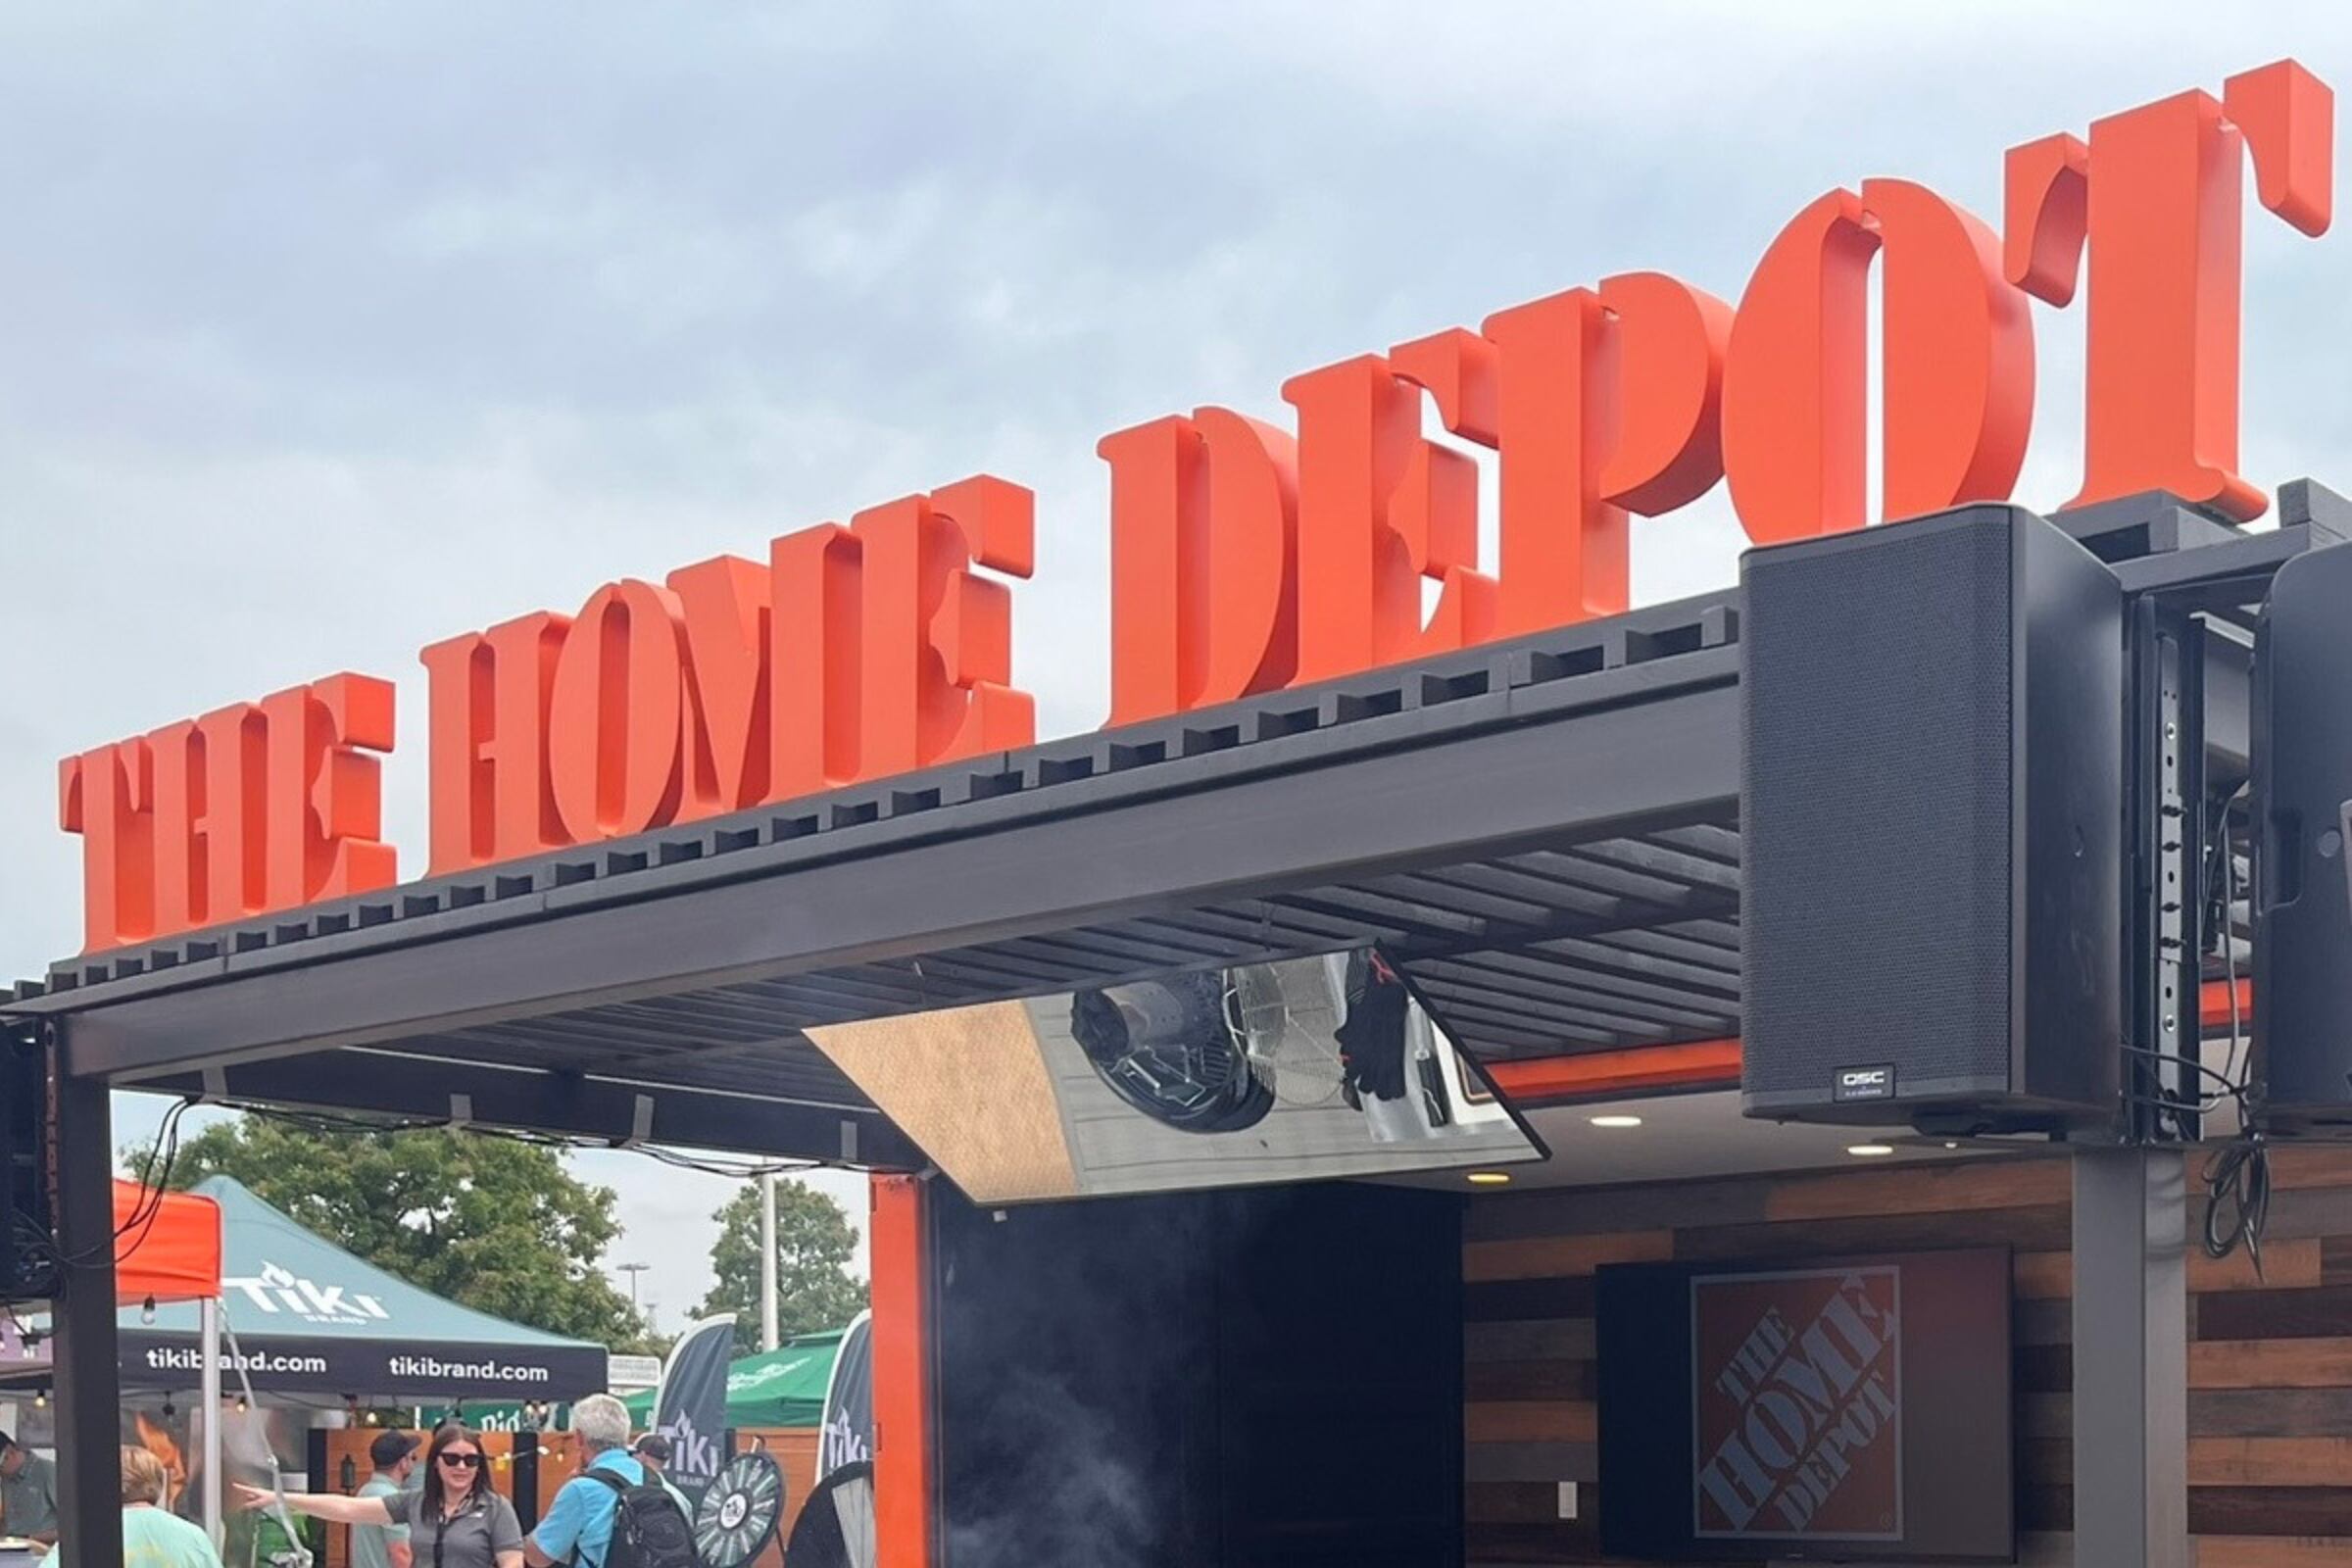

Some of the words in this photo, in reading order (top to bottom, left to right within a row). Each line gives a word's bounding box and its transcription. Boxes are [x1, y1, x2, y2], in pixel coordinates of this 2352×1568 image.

[59, 671, 398, 955] THE
[418, 473, 1036, 882] HOME
[1097, 58, 2335, 731] DEPOT
[1843, 1071, 1885, 1086] QSC
[146, 1348, 326, 1373] tikiband.com
[389, 1355, 549, 1382] tikibrand.com
[1700, 1272, 1896, 1530] HOME
[1716, 1303, 1795, 1406] THE
[1774, 1370, 1896, 1532] DEPOT
